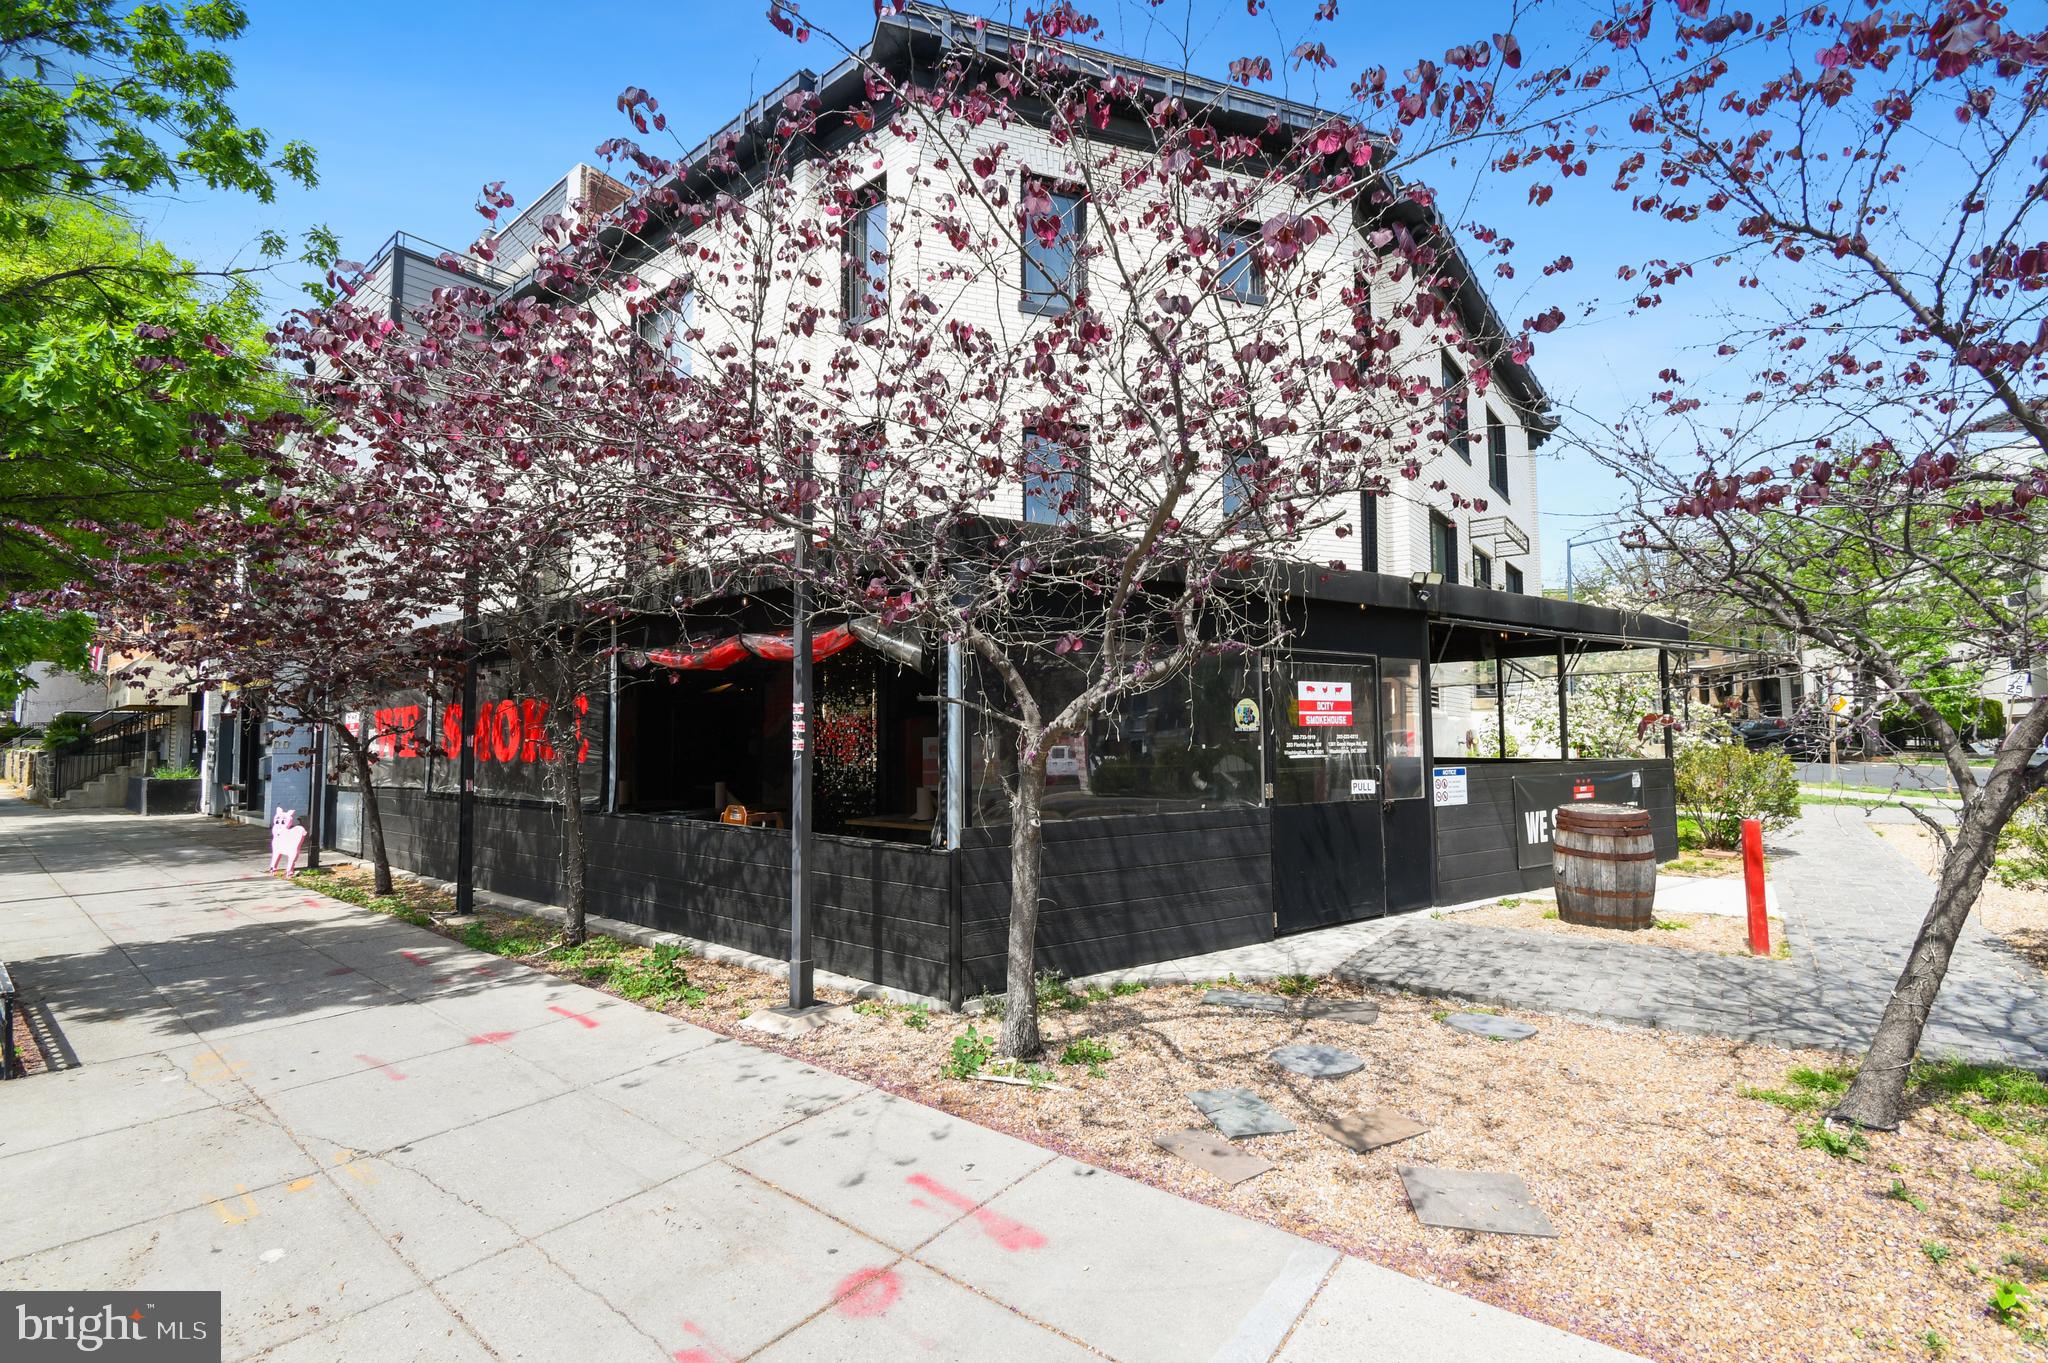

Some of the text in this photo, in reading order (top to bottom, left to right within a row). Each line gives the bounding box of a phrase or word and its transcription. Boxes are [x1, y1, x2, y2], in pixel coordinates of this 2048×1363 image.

[2007, 684, 2023, 694] 25
[1316, 701, 1335, 711] DCITY
[1305, 715, 1347, 725] SMOKEHOUSE
[374, 705, 419, 759] WE
[1352, 782, 1372, 791] PULL
[1524, 810, 1549, 844] WE
